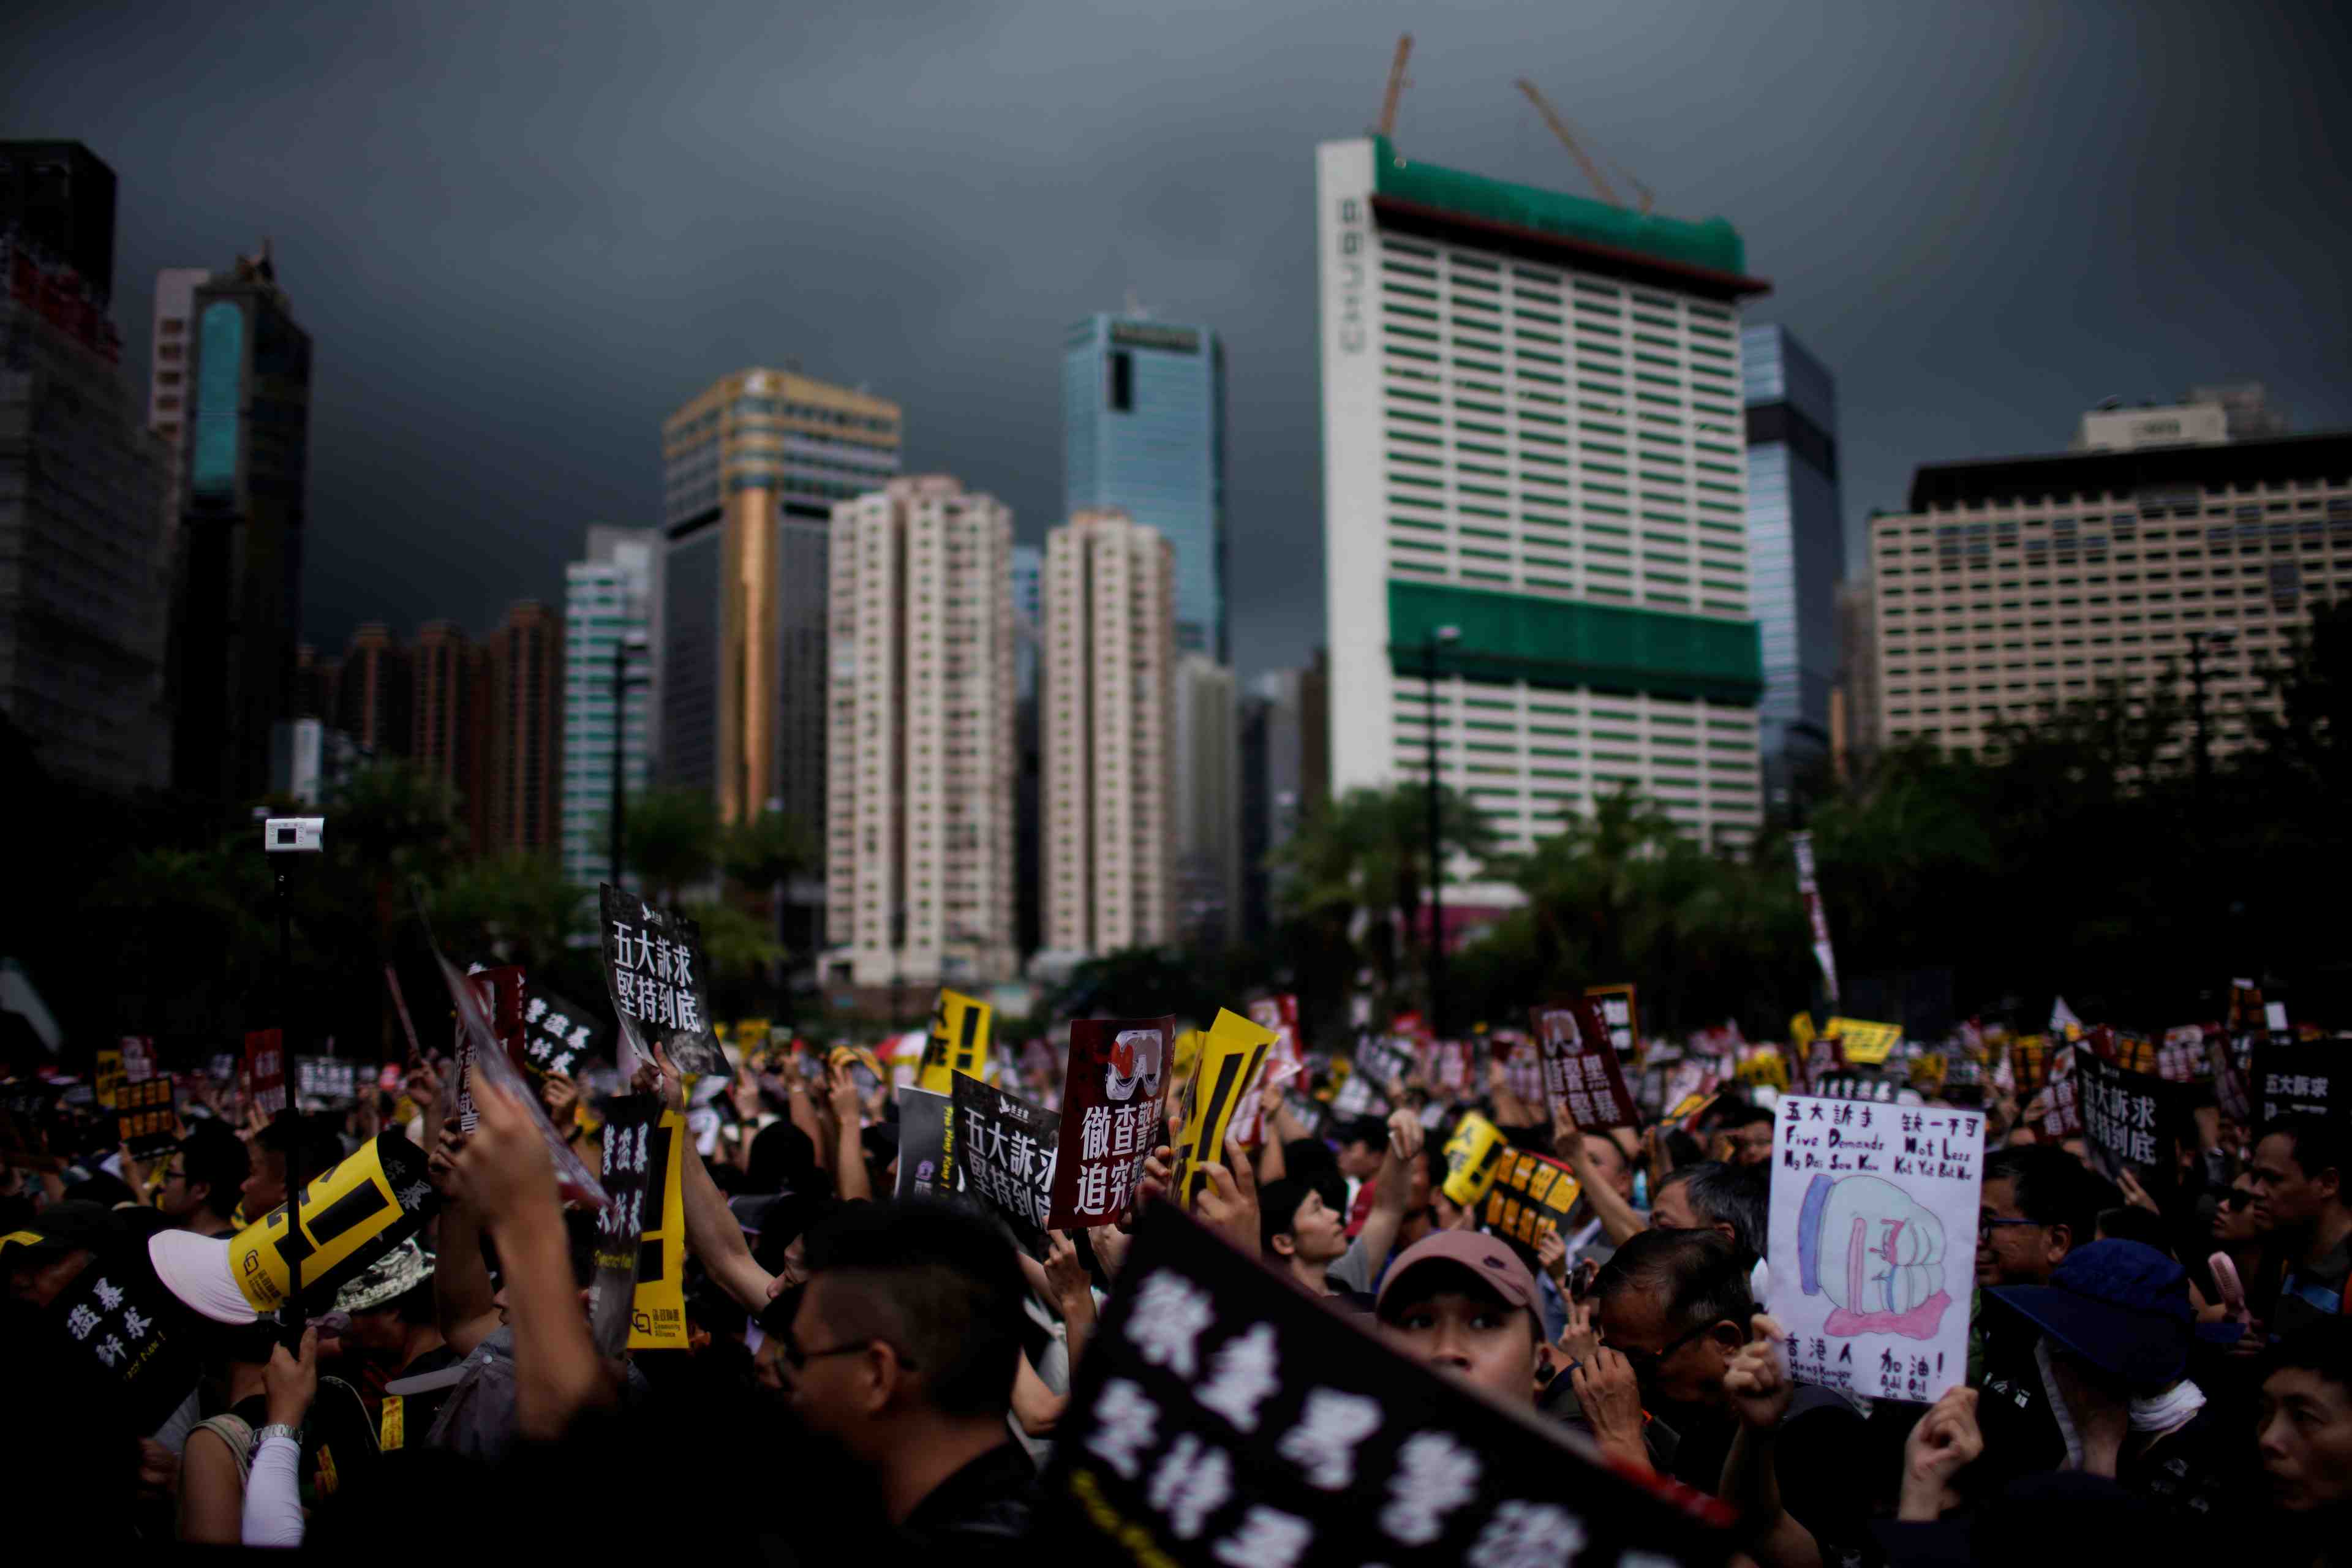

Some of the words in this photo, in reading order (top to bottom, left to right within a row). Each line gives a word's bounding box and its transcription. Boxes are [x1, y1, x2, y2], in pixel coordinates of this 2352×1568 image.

[612, 920, 692, 987] 五大訴求
[616, 968, 701, 1033] 堅持到底
[1902, 1112, 1979, 1137] 缺一不可
[1786, 1125, 1819, 1146] Five
[1828, 1128, 1884, 1150] Demands
[1943, 1137, 1971, 1162] Less
[1785, 1332, 1852, 1365] 香港人
